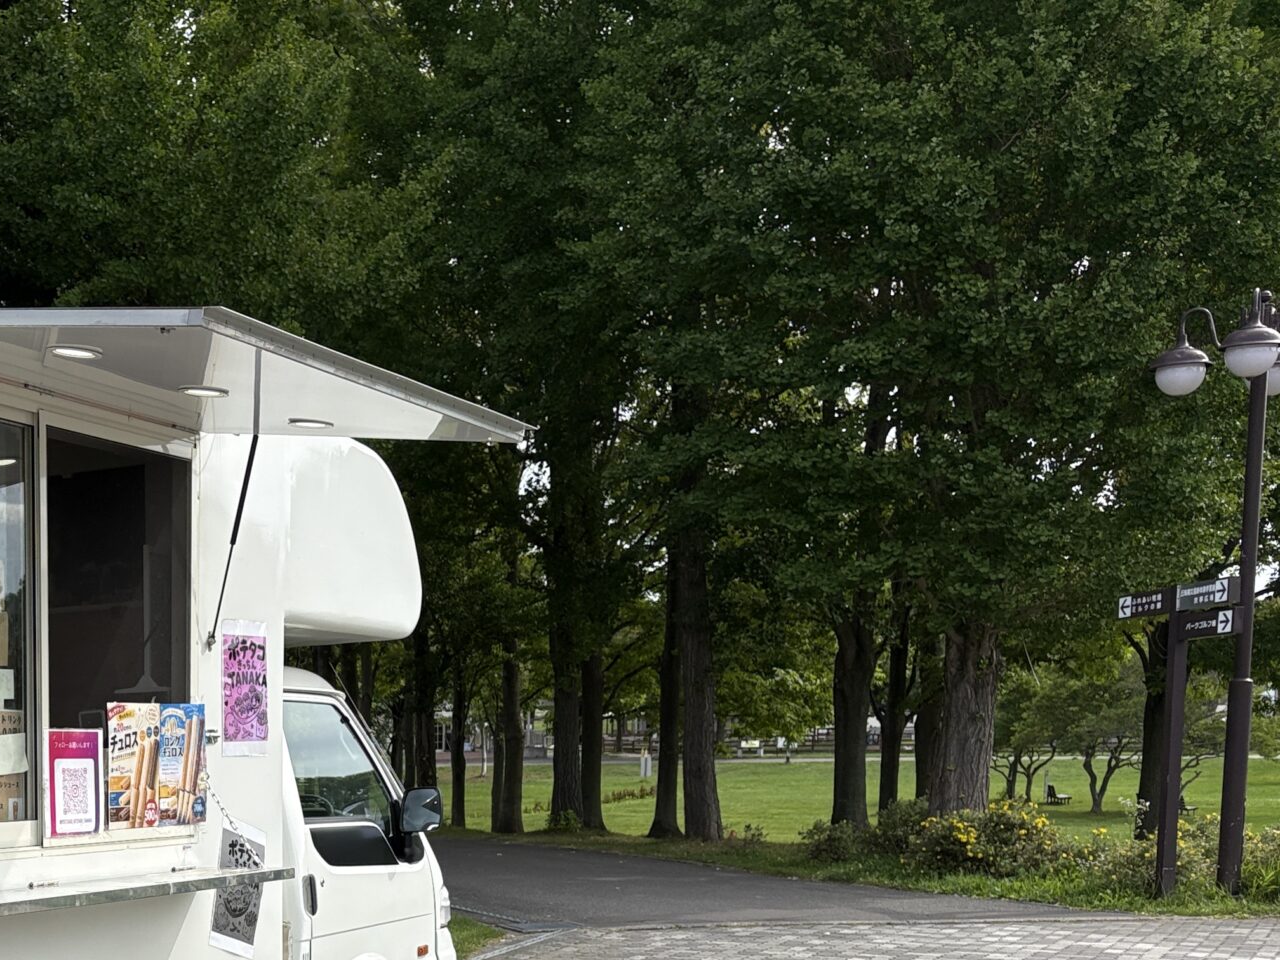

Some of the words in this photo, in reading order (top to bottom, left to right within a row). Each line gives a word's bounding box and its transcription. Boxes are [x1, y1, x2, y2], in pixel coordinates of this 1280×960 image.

[228, 637, 266, 661] ポテタコ
[227, 671, 267, 689] TANAKA
[110, 731, 139, 754] チュロス
